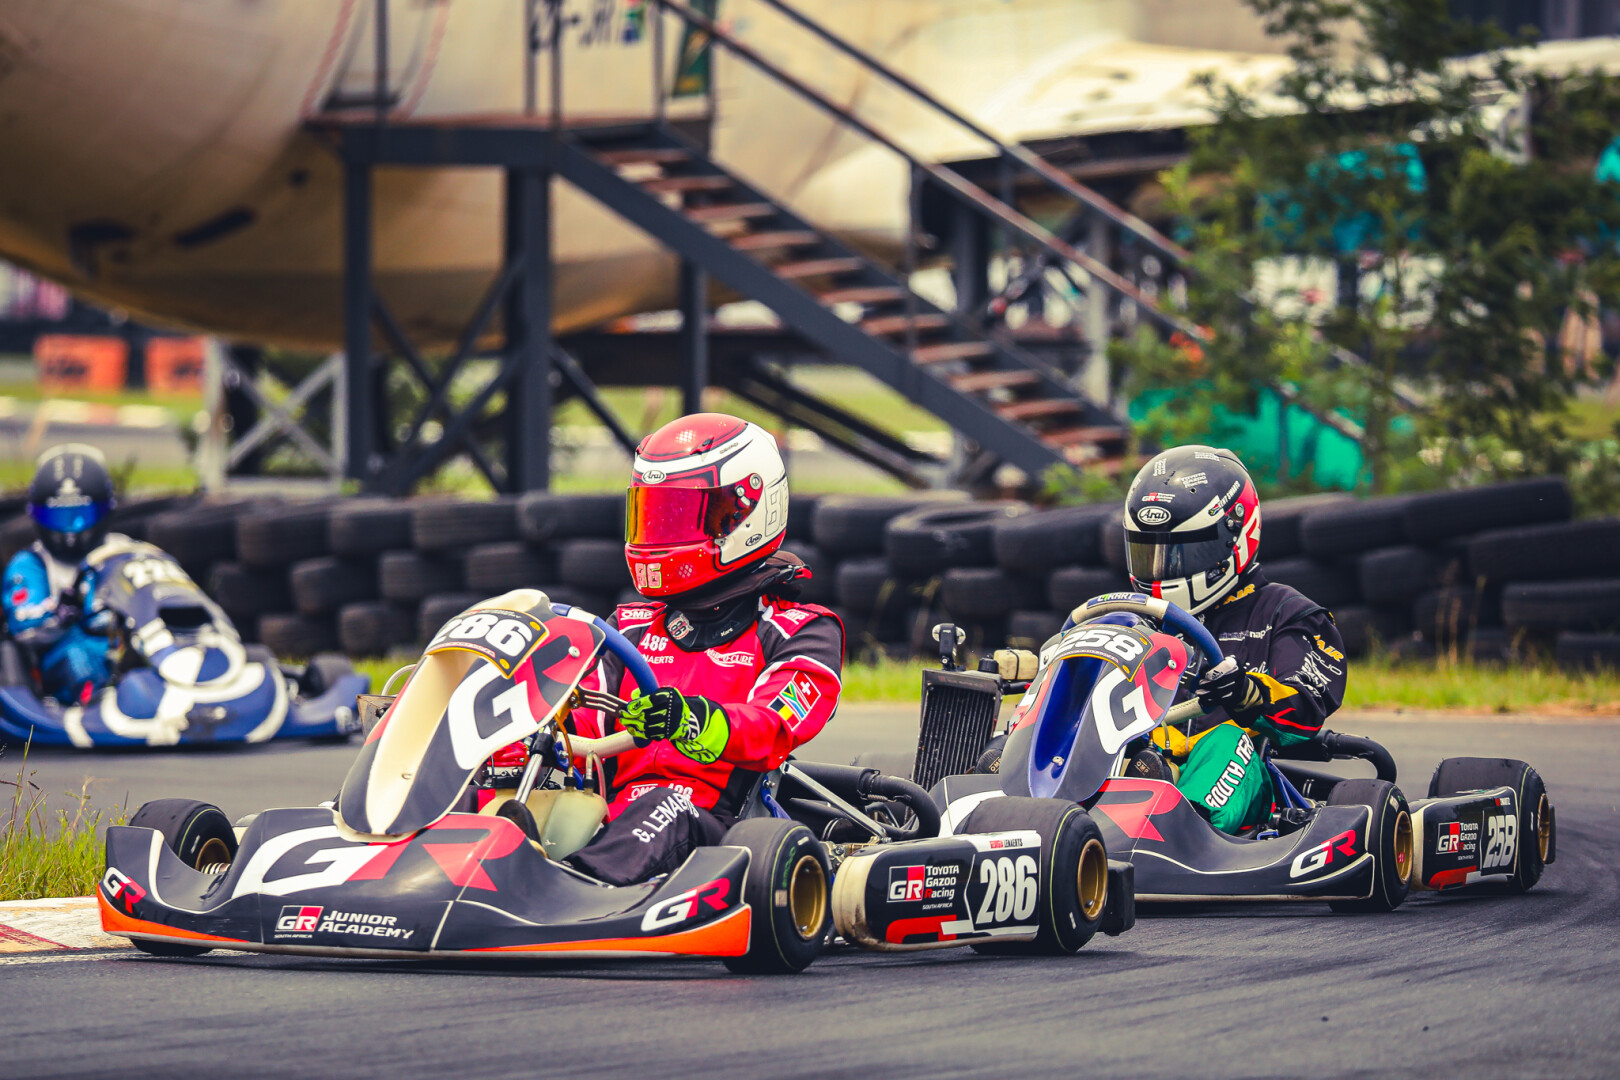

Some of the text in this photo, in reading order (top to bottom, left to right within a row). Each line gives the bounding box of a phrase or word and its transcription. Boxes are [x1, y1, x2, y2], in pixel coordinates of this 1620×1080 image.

[1141, 509, 1166, 519] Arai
[621, 609, 654, 621] OMP
[640, 633, 669, 651] 486
[1055, 629, 1144, 662] 258
[642, 654, 674, 664] NAERTS
[1204, 760, 1246, 808] SOUTH
[1437, 834, 1460, 852] GR
[1289, 829, 1357, 878] GR
[925, 864, 960, 876] TOYOTA
[103, 866, 147, 914] GR
[889, 879, 924, 900] GR
[925, 876, 957, 887] GAZOO
[975, 854, 1038, 925] 286
[924, 887, 955, 900] Racing
[641, 877, 730, 932] GR
[276, 915, 318, 931] GR
[323, 910, 398, 926] JUNIOR
[317, 921, 415, 939] ACADEMY
